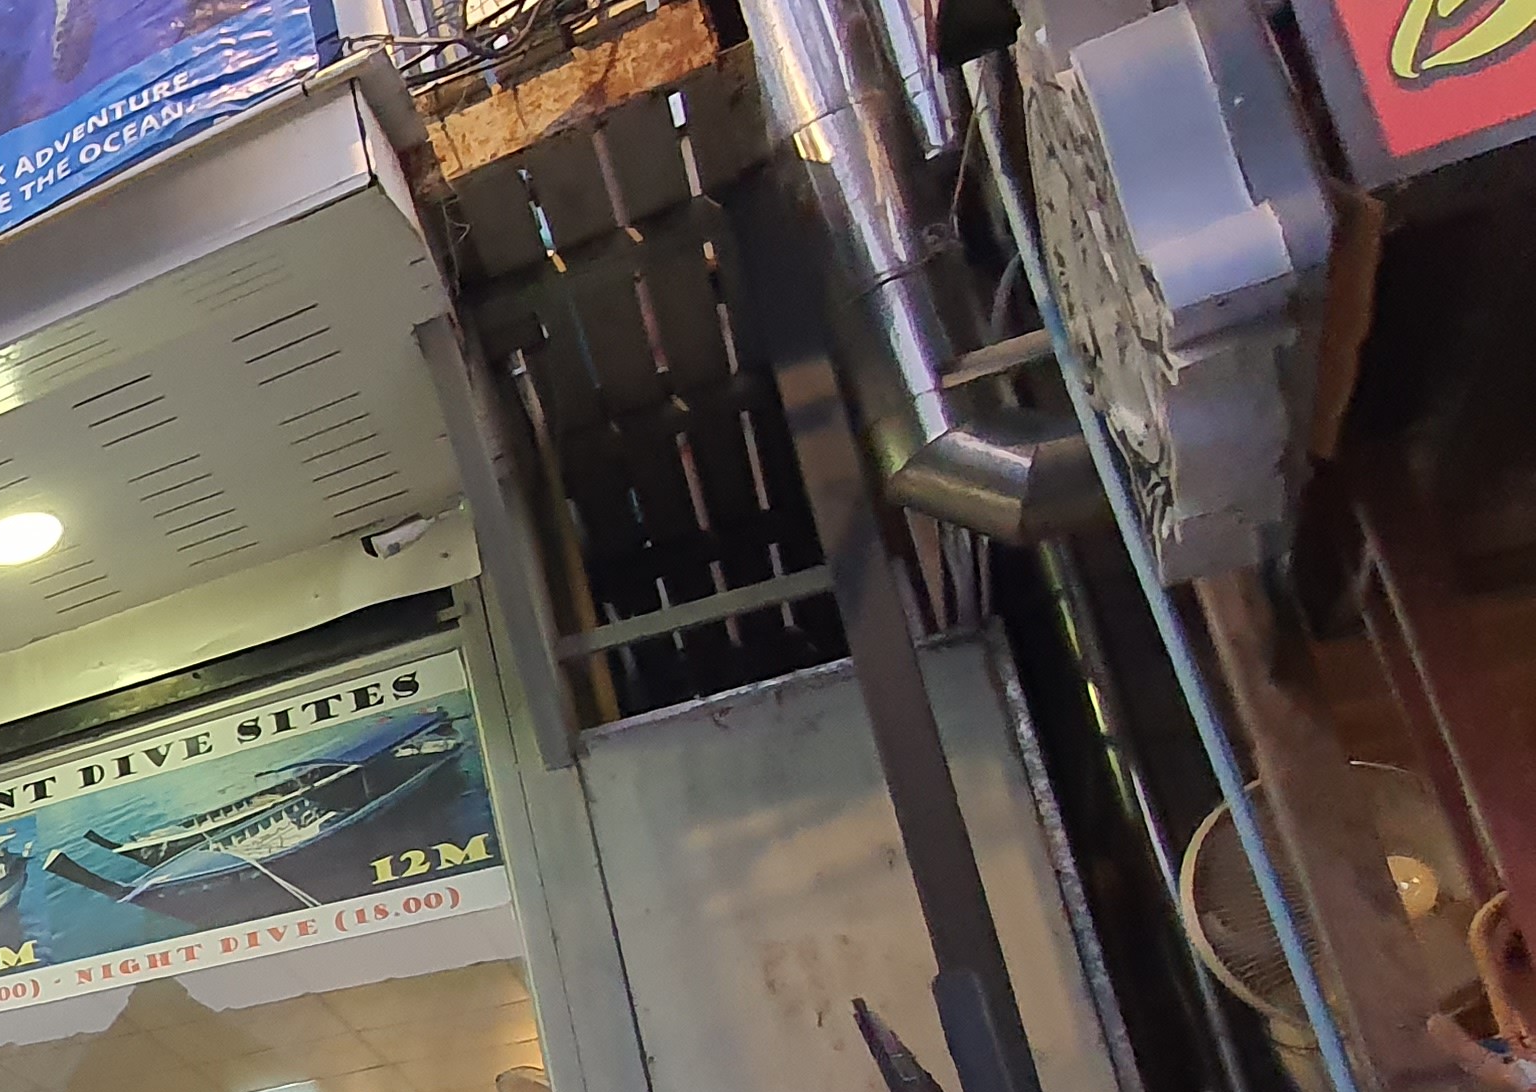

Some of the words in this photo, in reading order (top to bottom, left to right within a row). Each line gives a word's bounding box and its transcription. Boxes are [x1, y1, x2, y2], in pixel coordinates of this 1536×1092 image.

[14, 71, 199, 179] ADVENTURE.
[20, 157, 72, 201] THE
[79, 101, 195, 165] OCEAN.
[78, 731, 214, 788] DIVE
[237, 671, 421, 744] SITES
[370, 833, 494, 885] 12M
[76, 942, 203, 986] NIGHT
[219, 917, 319, 954] DIVE
